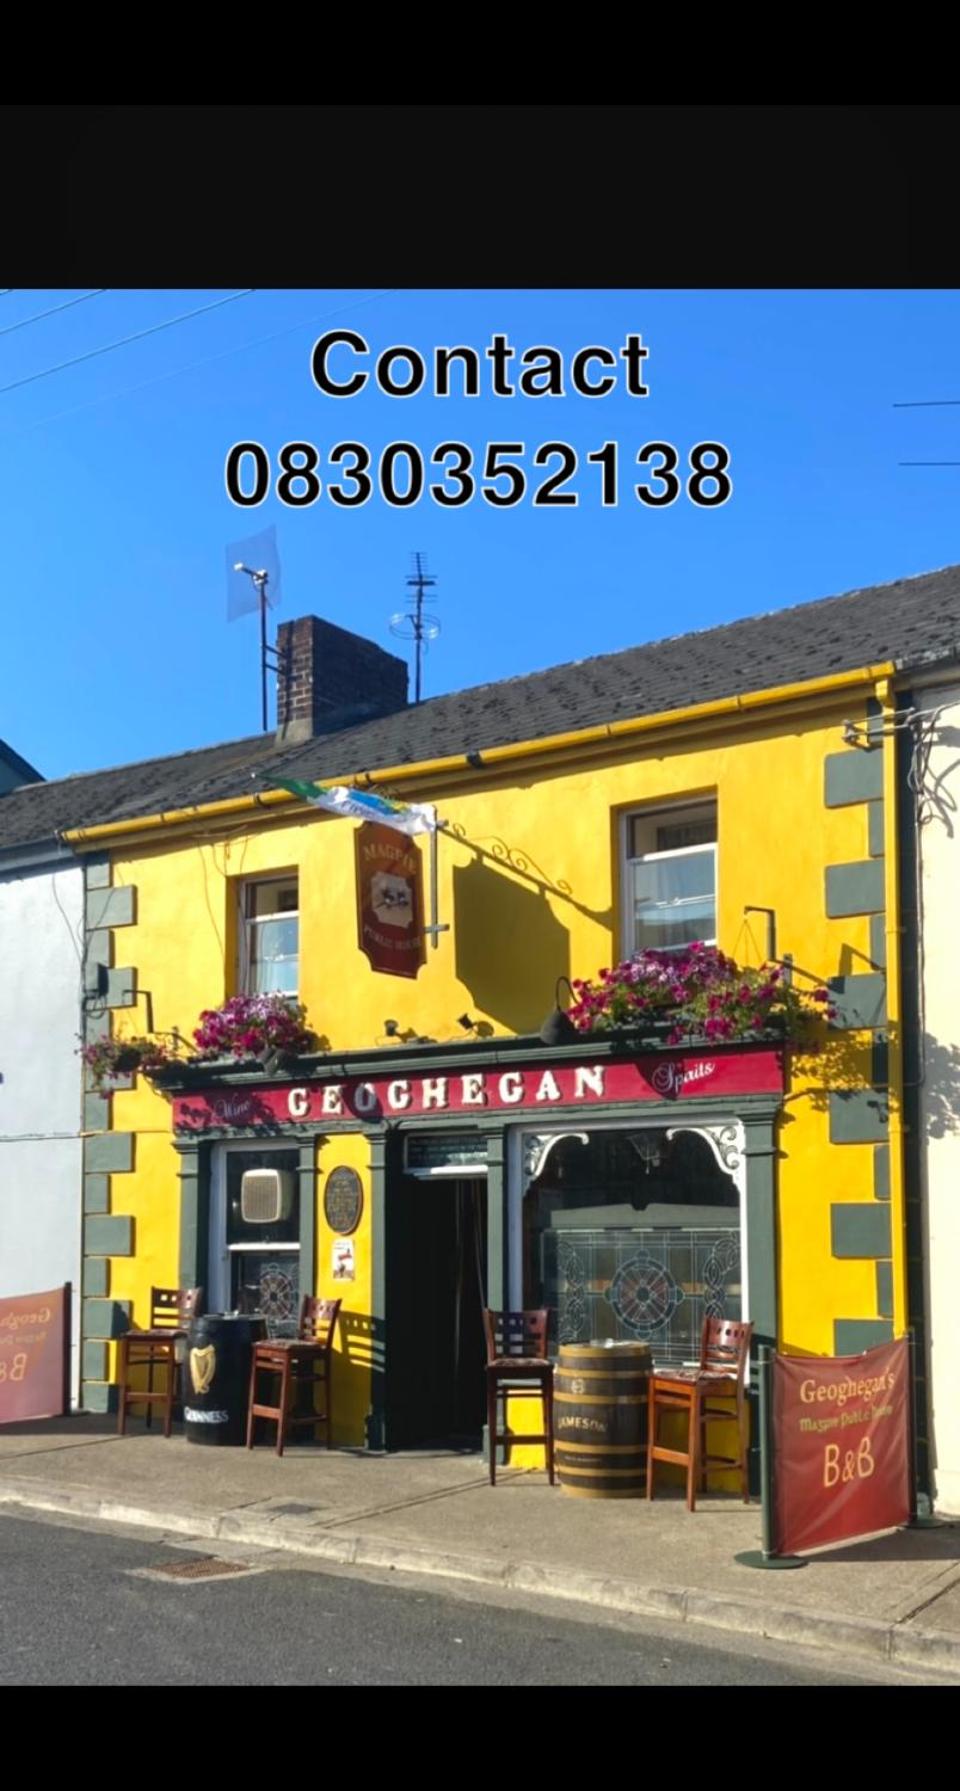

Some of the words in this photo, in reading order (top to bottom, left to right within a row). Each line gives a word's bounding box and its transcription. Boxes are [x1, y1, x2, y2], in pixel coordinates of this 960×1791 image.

[287, 1064, 606, 1117] GEOGHEGAN
[652, 1061, 716, 1093] Spirits
[800, 1368, 894, 1407] Geoghegan's
[184, 1406, 229, 1424] GUINNESS
[558, 1415, 607, 1433] JAMESON
[823, 1436, 875, 1488] B&B
